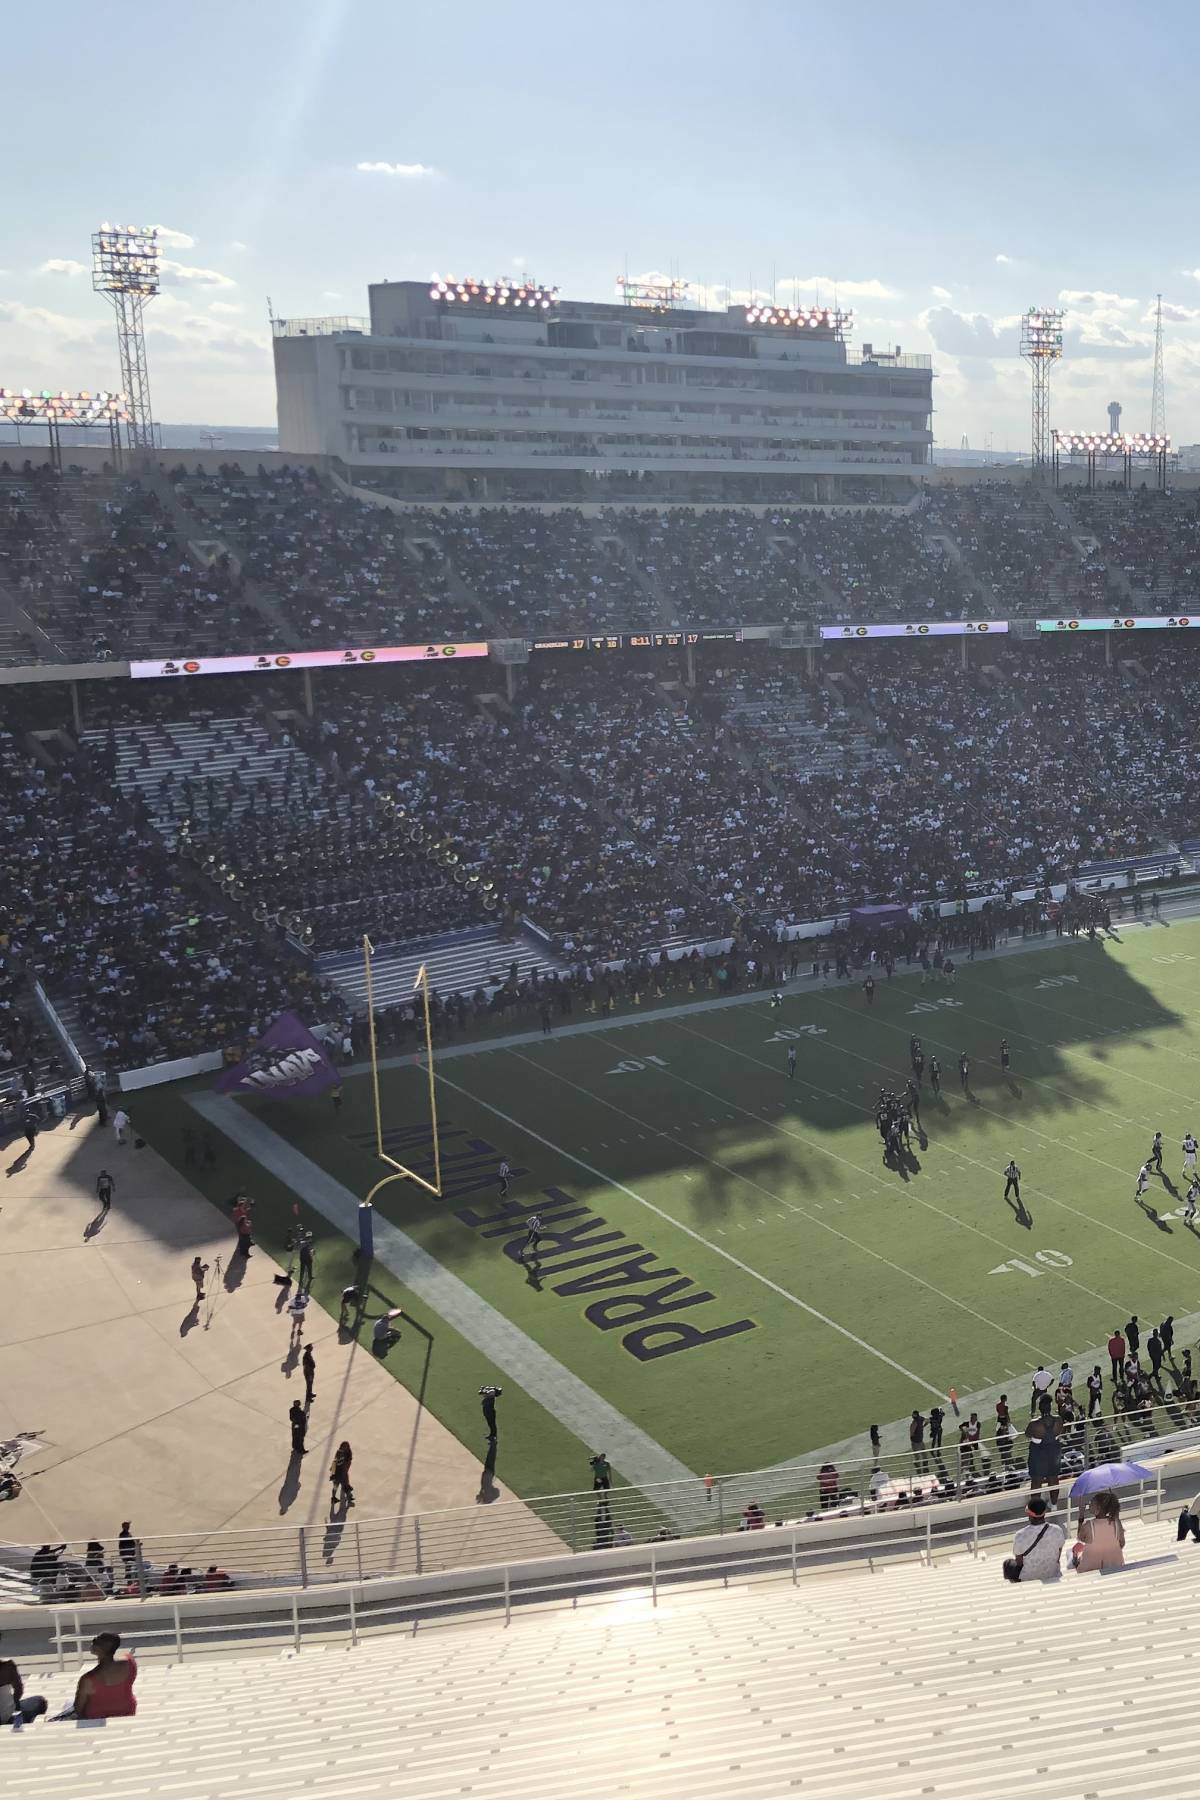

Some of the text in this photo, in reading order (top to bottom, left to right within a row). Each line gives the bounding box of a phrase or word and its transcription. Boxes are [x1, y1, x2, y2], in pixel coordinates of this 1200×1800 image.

[618, 1055, 671, 1072] 10
[453, 1186, 761, 1363] PRAIRIE
[1006, 1249, 1074, 1278] 10
